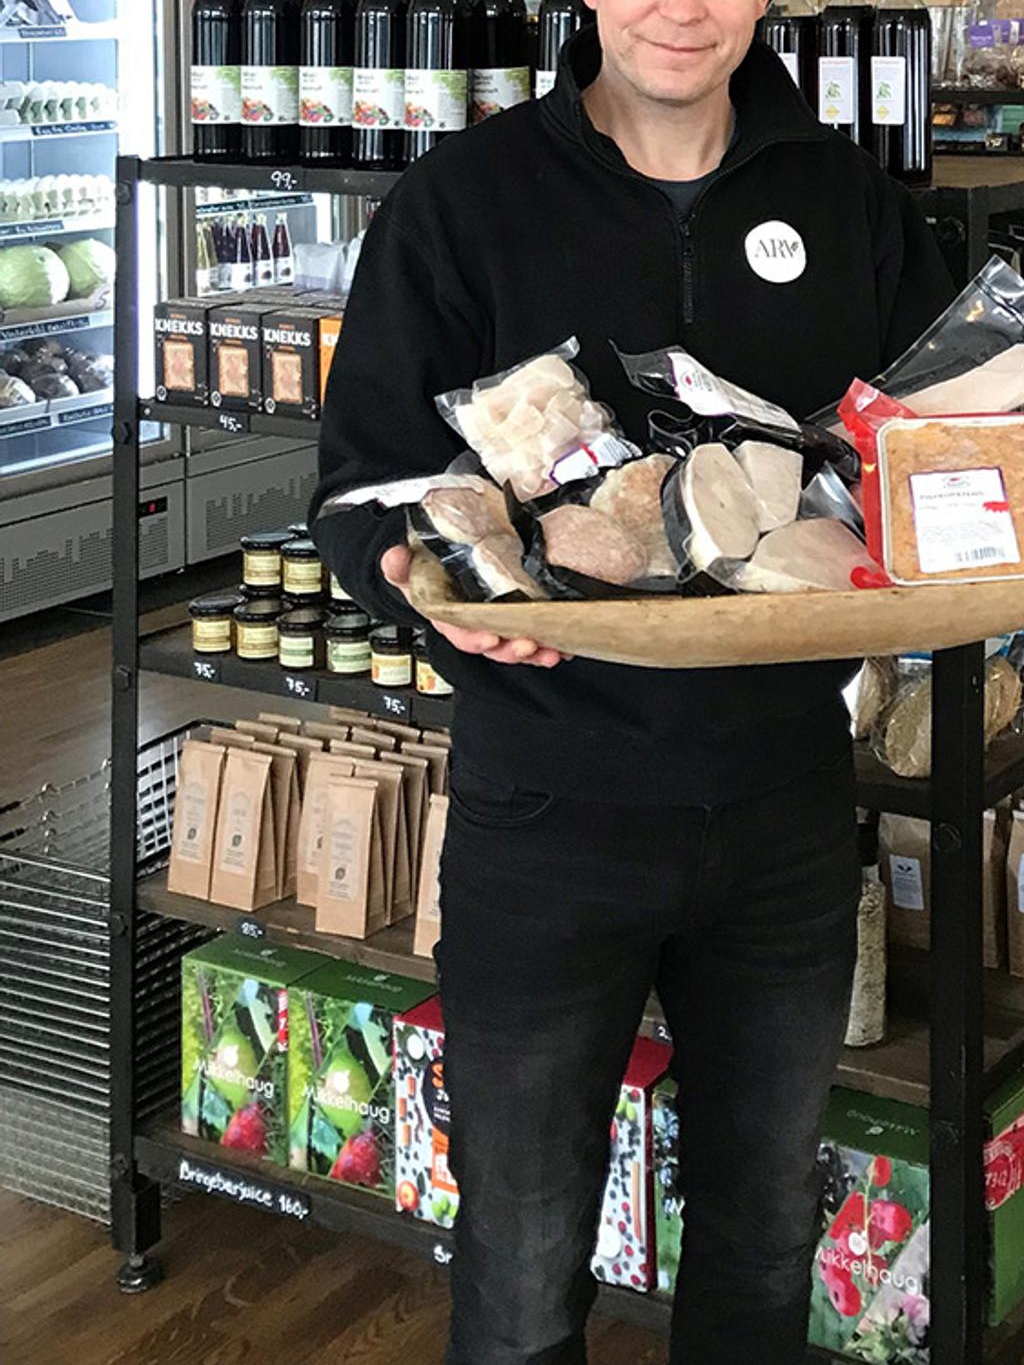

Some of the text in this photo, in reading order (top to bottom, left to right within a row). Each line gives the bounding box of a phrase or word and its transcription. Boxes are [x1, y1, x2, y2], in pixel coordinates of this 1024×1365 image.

[154, 318, 204, 336] KNEKKS
[208, 321, 259, 340] KNEKKS
[263, 327, 312, 347] KNEKKS
[218, 413, 243, 433] 45,-
[193, 661, 216, 679] 75,-
[285, 678, 310, 697] 75,-
[383, 695, 406, 715] 75,-
[193, 1058, 275, 1099] Mikkelhaug
[301, 1084, 390, 1124] Mikkelhaug
